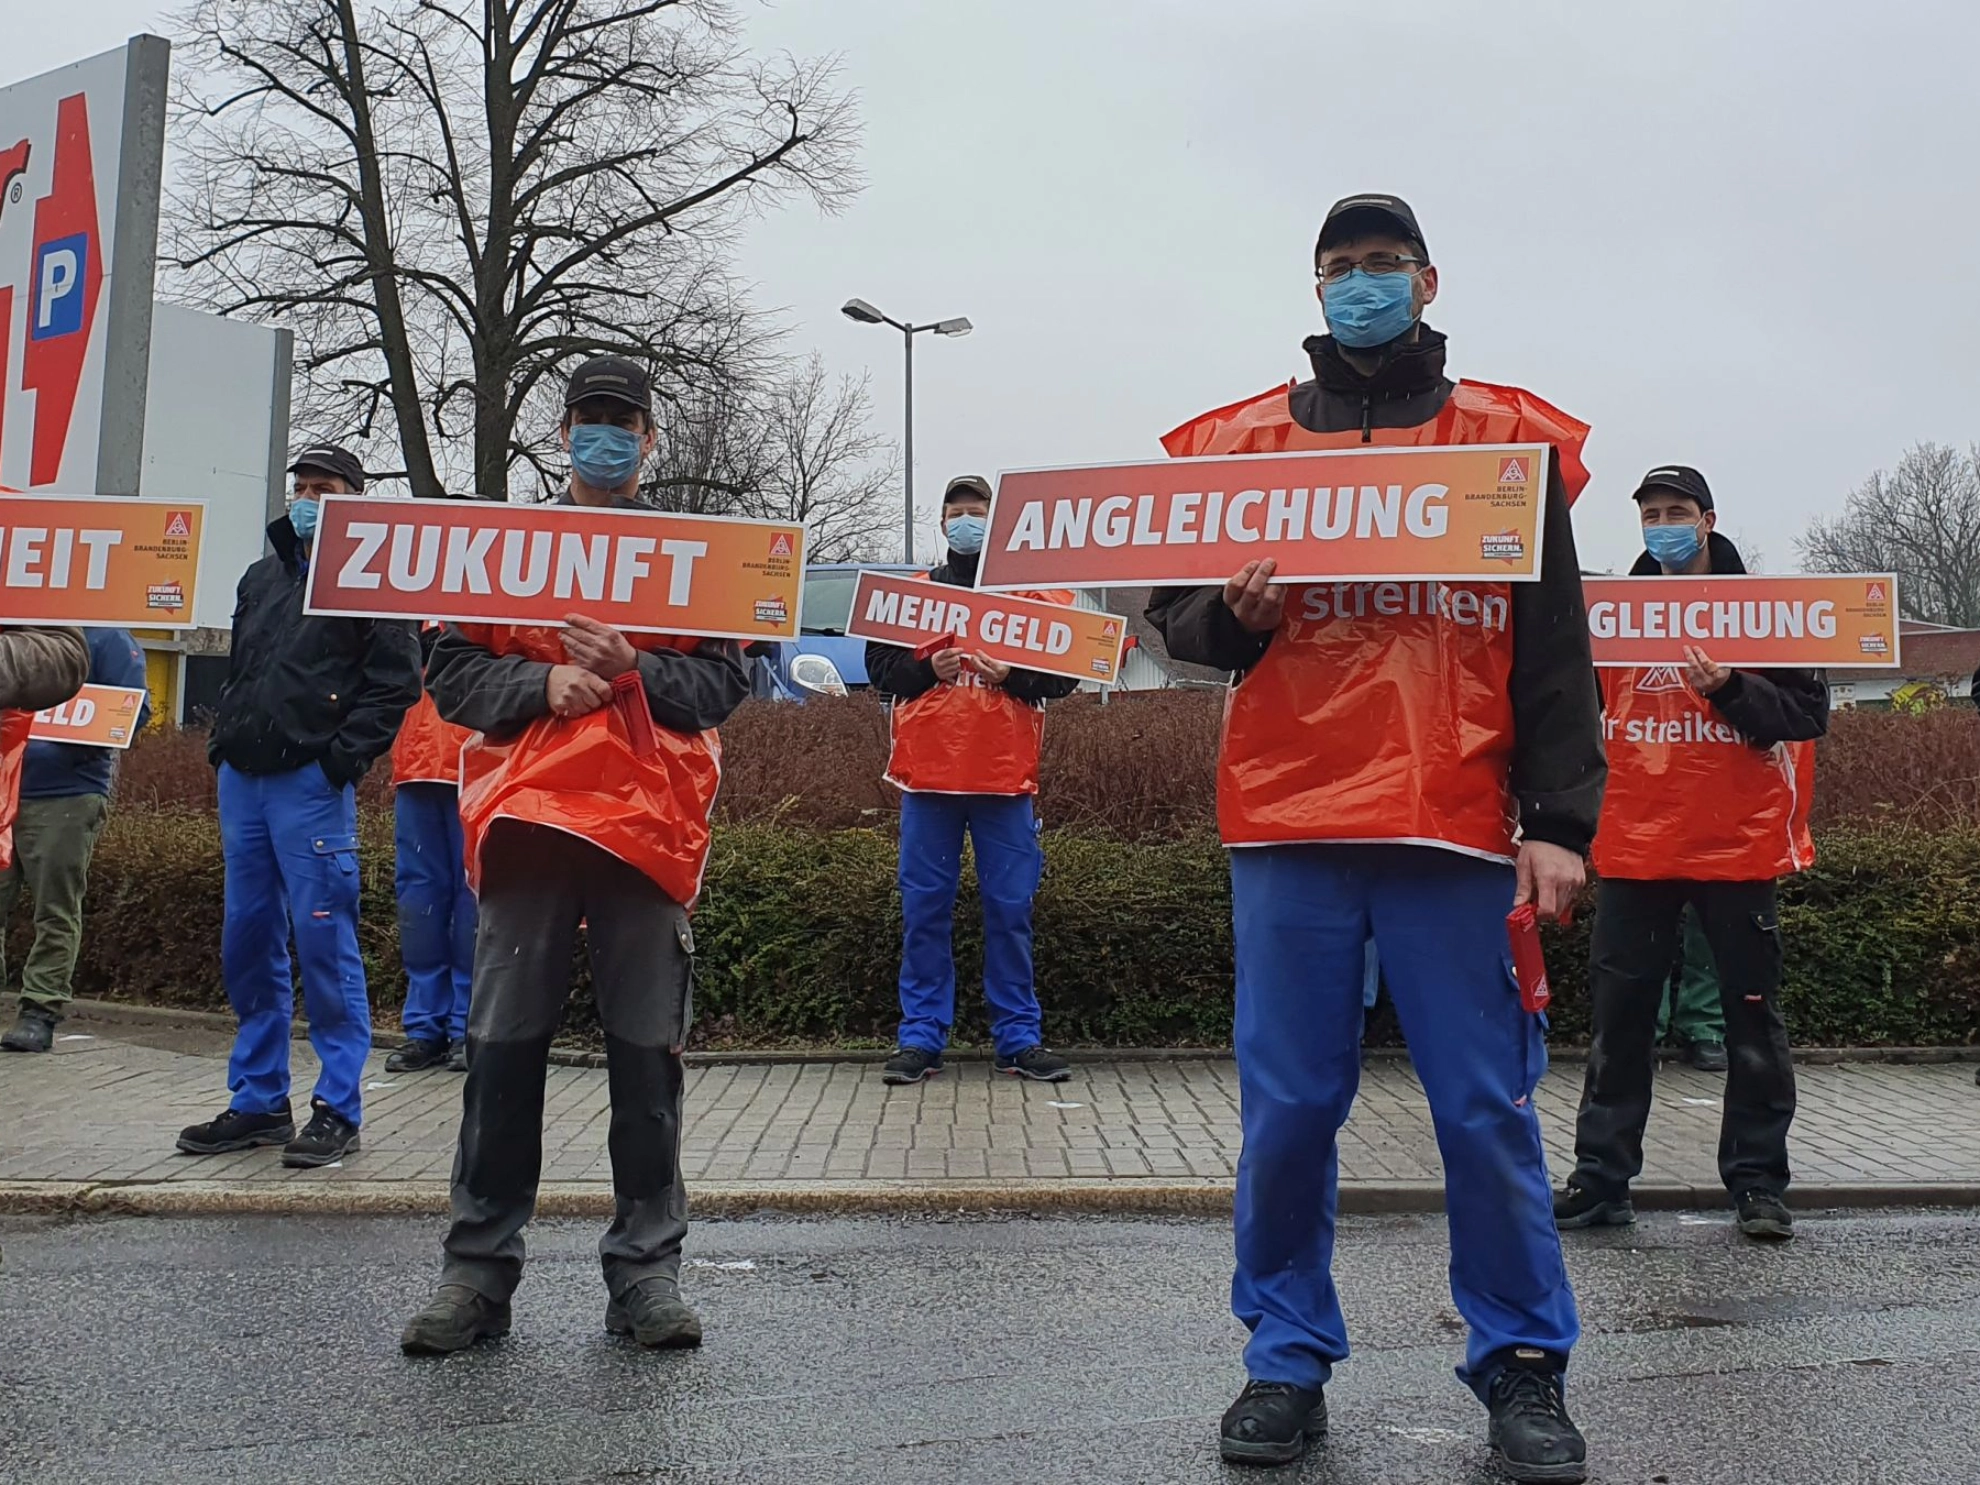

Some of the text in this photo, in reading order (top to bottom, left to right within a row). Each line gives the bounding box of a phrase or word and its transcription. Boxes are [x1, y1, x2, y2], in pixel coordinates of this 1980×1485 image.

[38, 249, 77, 328] P
[1005, 483, 1449, 552] ANGLEICHUNG
[0, 526, 123, 590] EIT
[337, 522, 708, 607] ZUKUNFT
[864, 589, 1072, 655] MEHR GELD
[1302, 580, 1508, 632] streiken
[1588, 600, 1837, 639] GLEICHUNG
